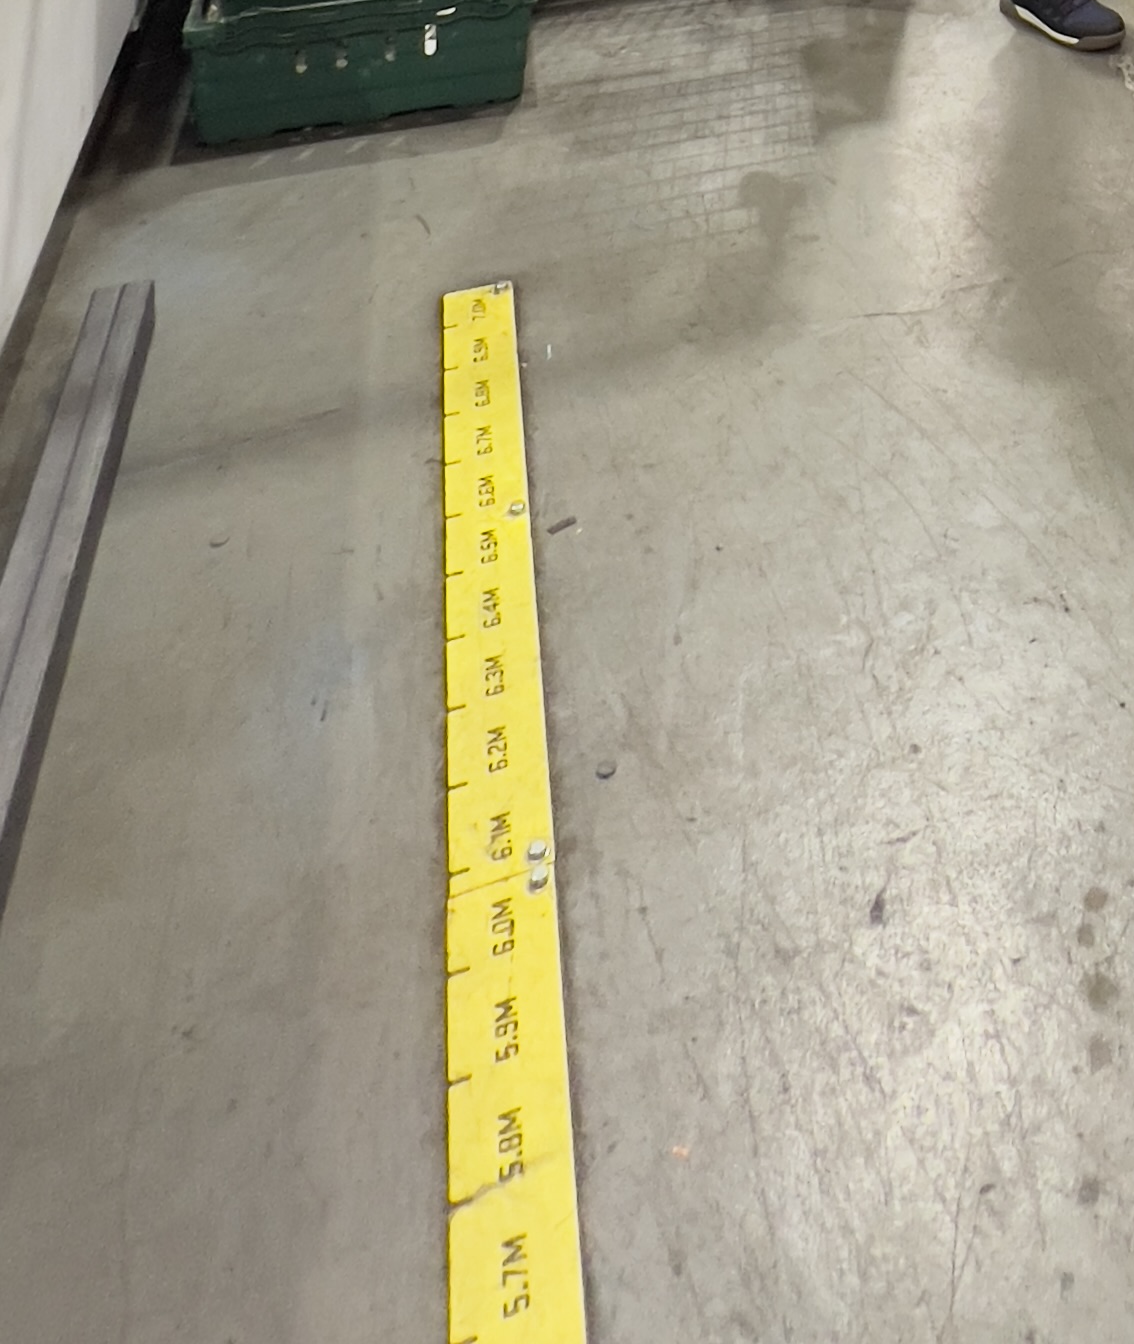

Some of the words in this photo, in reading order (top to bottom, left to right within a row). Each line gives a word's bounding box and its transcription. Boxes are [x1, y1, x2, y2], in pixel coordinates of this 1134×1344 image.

[472, 298, 486, 322] 7.0M
[473, 337, 489, 364] 6.9M
[475, 378, 490, 408] 6.8M
[476, 424, 492, 456] 6.7M
[479, 474, 494, 508] 6.6M
[481, 528, 498, 565] 6.5M
[483, 587, 501, 629] 6.4M
[484, 653, 505, 697] 6.3M
[488, 724, 508, 774] 6.2M
[489, 810, 513, 861] 6.1M
[492, 897, 515, 957] 6.0M
[494, 996, 520, 1064] 5.9M
[497, 1106, 524, 1184] 5.8M
[501, 1231, 530, 1320] 5.7M
